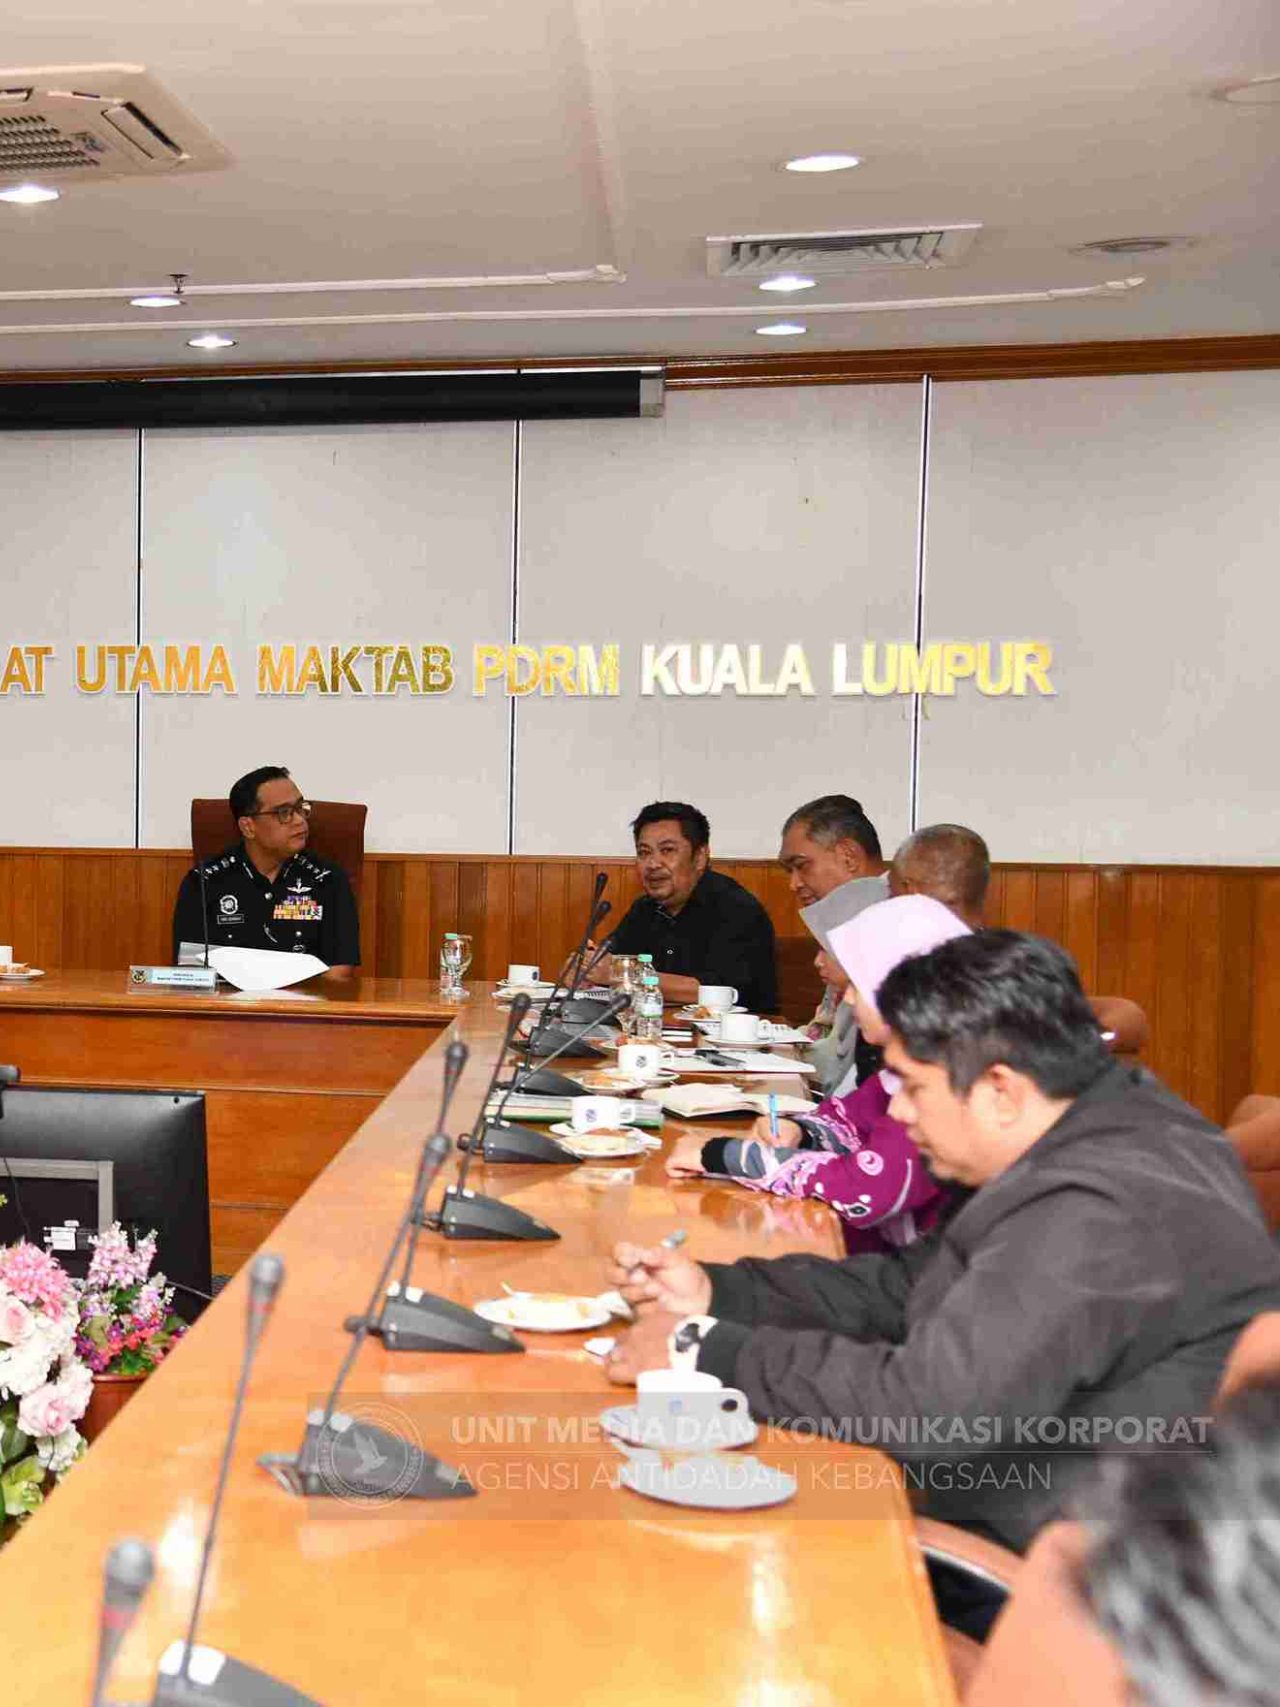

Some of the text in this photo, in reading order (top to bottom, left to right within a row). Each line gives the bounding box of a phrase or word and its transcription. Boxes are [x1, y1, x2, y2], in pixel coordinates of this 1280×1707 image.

[75, 644, 239, 695] UTAMA
[256, 643, 455, 696] MAKTAB
[472, 643, 620, 697] PDRM
[640, 643, 815, 697] KUALA
[832, 642, 1056, 697] LUMPUR
